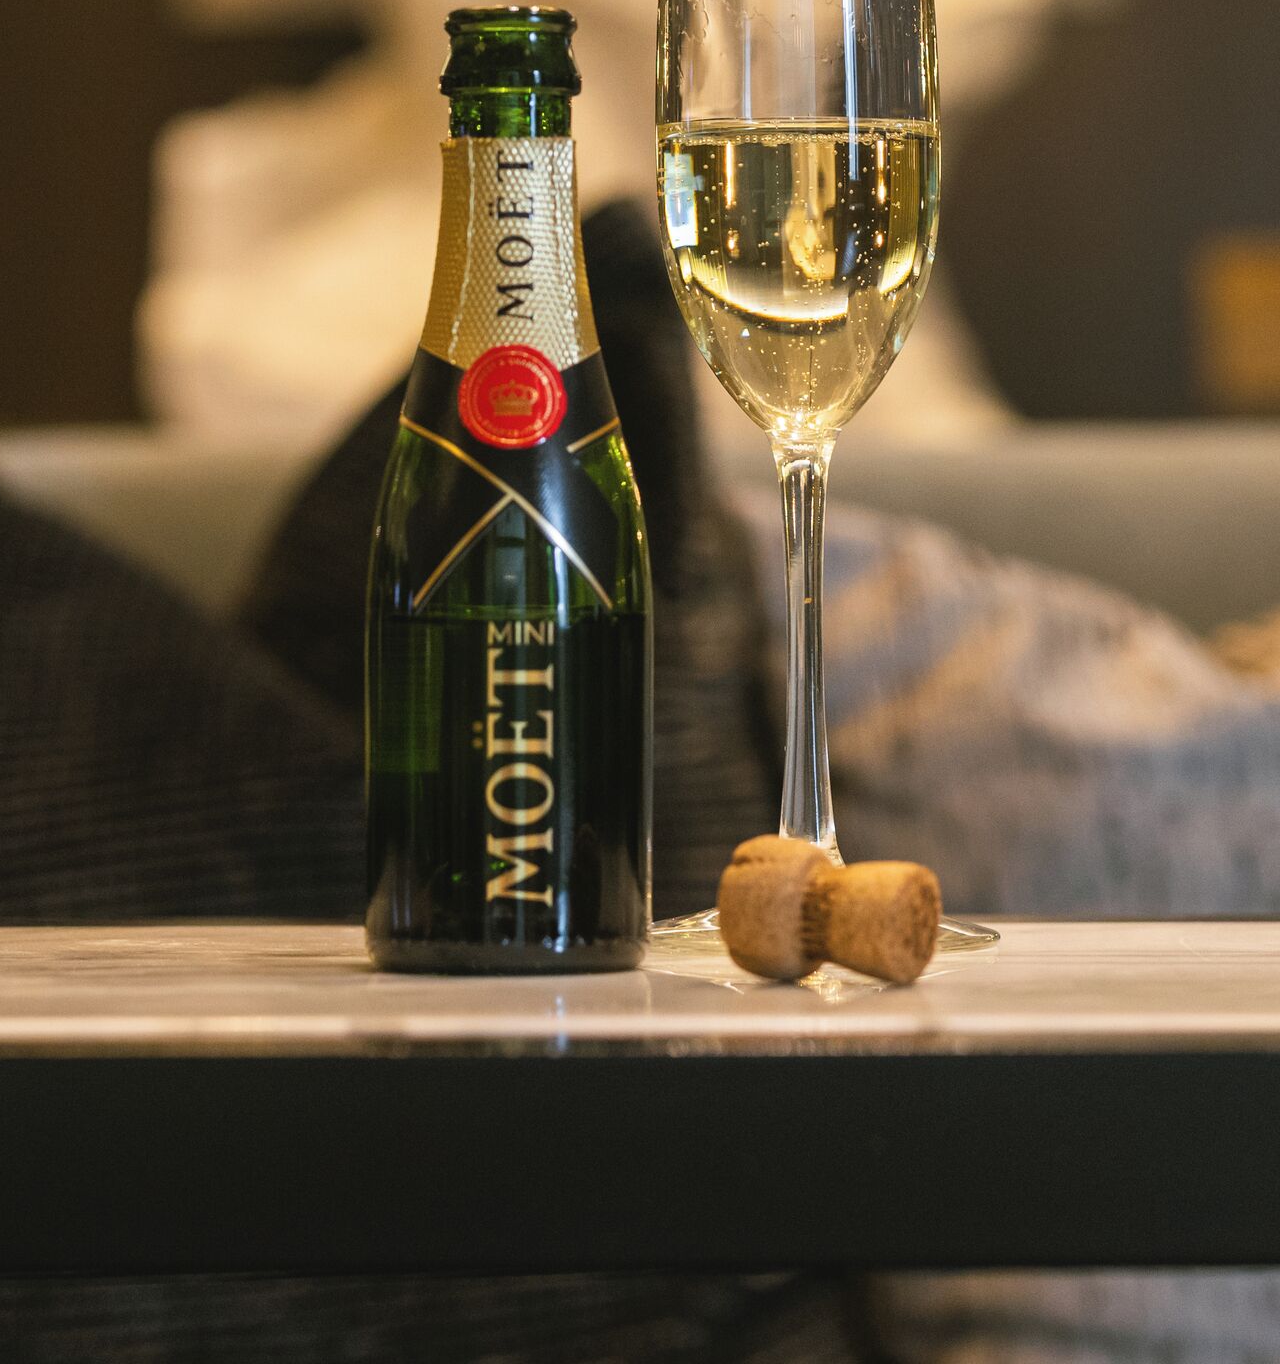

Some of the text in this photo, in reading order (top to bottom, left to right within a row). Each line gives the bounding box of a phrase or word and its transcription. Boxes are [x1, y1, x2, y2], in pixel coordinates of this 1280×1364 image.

[489, 150, 534, 321] MOËT
[487, 620, 554, 645] MINI
[471, 647, 554, 907] MOËT
